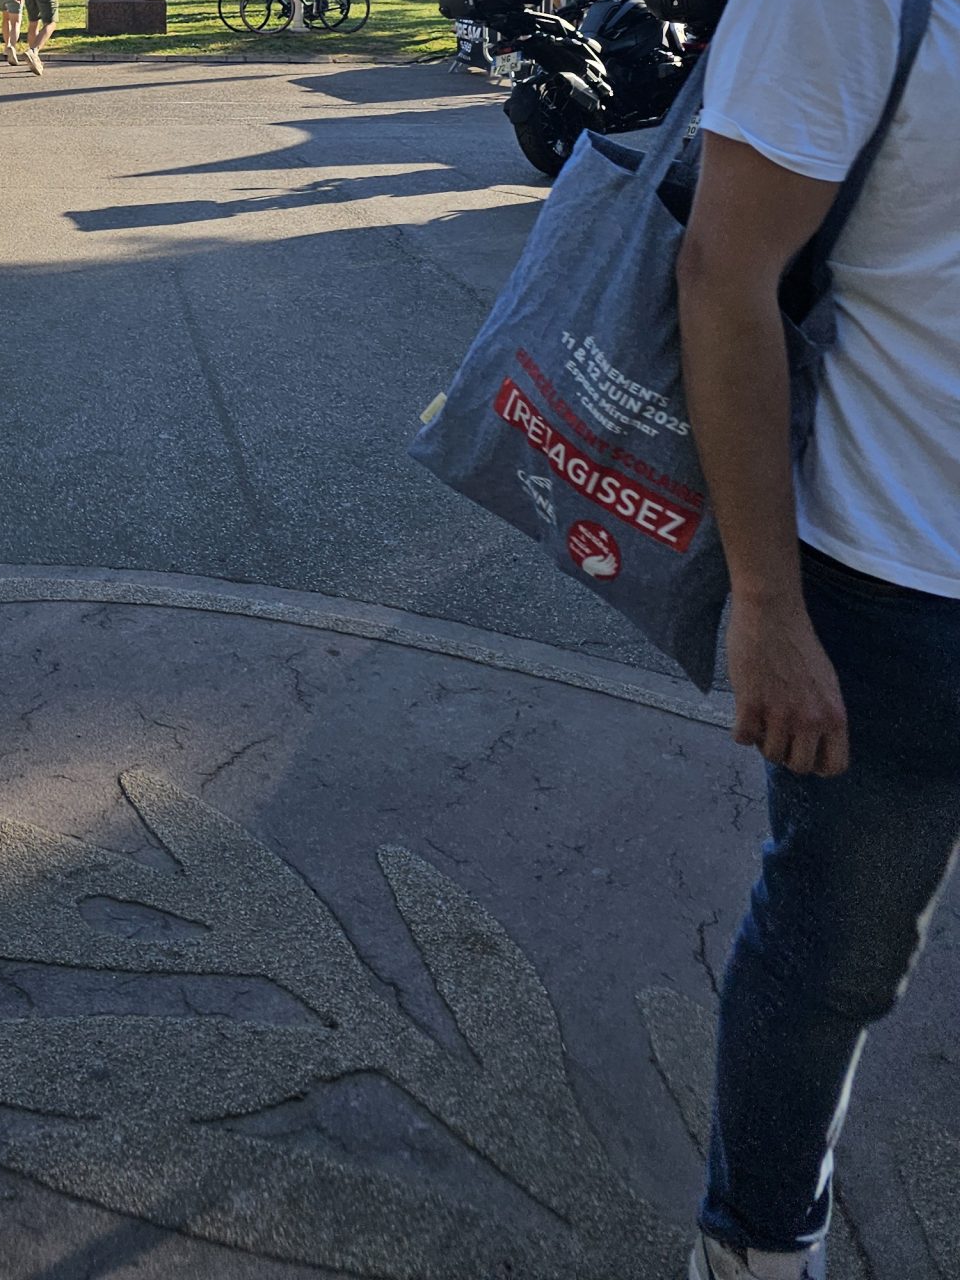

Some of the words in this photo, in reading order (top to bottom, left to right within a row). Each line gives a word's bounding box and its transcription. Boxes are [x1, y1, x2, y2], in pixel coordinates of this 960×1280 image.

[561, 331, 576, 350] 11
[573, 347, 586, 363] &
[586, 361, 600, 381] 12
[598, 381, 642, 413] JUIN
[642, 405, 690, 436] 2025
[565, 360, 599, 401] Espace
[583, 335, 670, 408] ÉVÉNEMENTS
[503, 388, 686, 543] [RÉ]AGISSEZ
